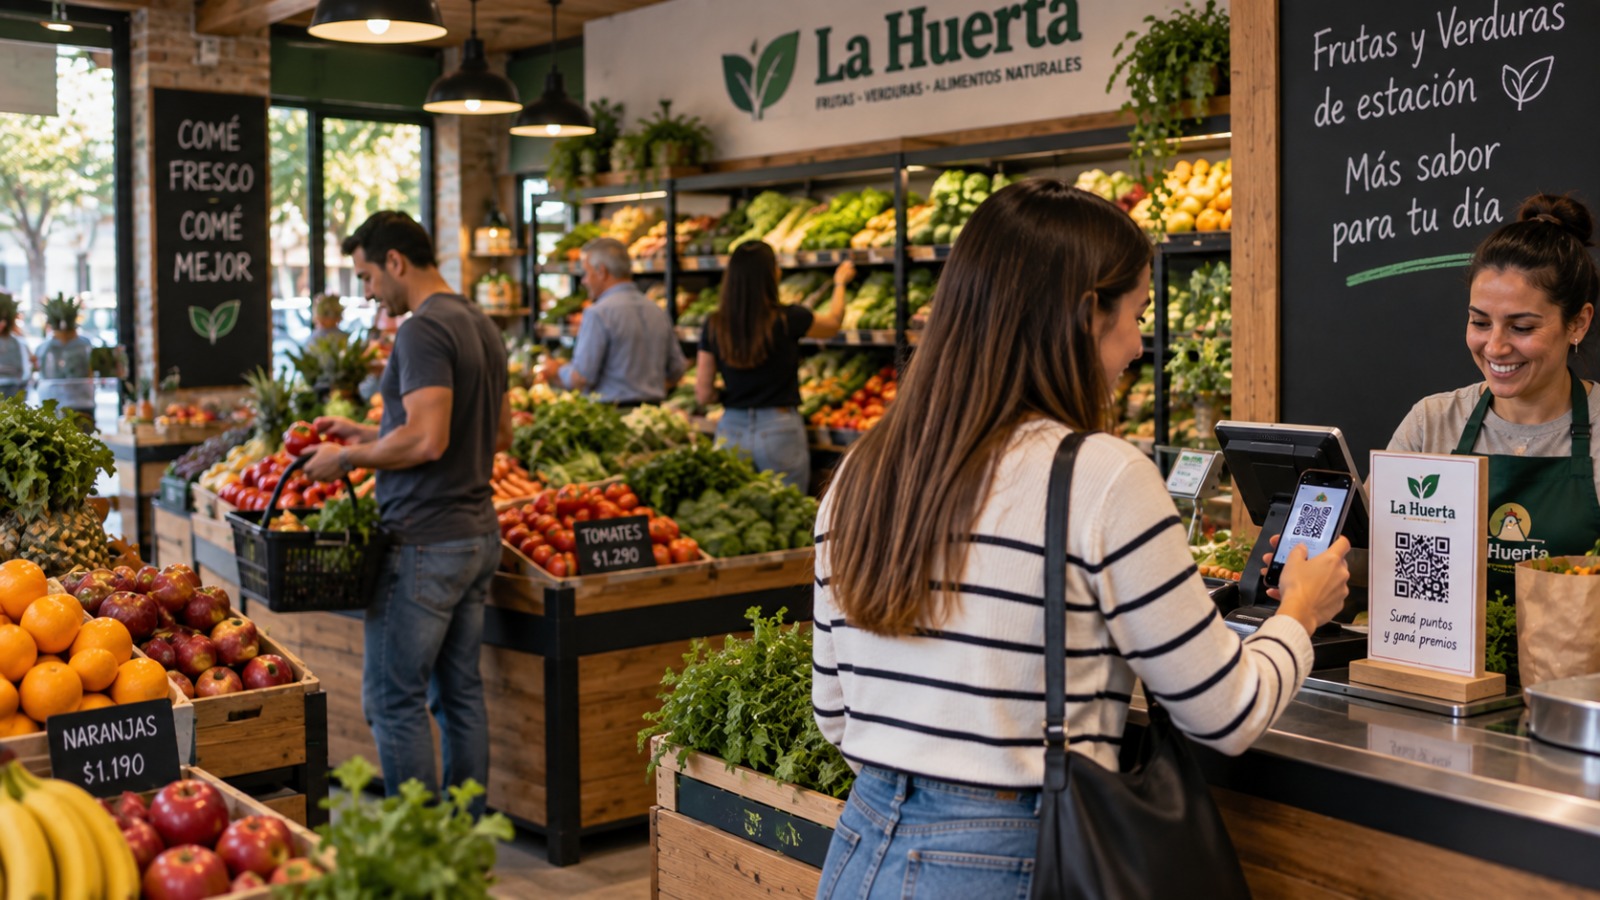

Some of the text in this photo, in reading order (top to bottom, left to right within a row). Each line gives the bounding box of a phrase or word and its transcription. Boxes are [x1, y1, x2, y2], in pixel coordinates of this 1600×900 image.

[815, 0, 1082, 85] La Huerta
[1314, 0, 1566, 71] Frutas y Verduras
[815, 56, 1082, 110] FRUTAS VERDURAS ALIMENTOS NATURALES
[1314, 67, 1478, 128] de estación
[177, 114, 241, 151] COMÉ
[169, 159, 254, 192] FRESCO
[1345, 132, 1501, 195] Más sabor
[180, 203, 244, 241] COMÉ
[1333, 186, 1504, 263] para tu día
[173, 251, 254, 283] MEJOR
[1390, 500, 1456, 520] La Huerta
[580, 523, 643, 545] TOMATES
[592, 546, 639, 568] $1.290
[1487, 543, 1549, 561] Huerta
[1389, 608, 1453, 631] Sumá puntos
[1384, 629, 1457, 650] y ganá premios
[63, 715, 158, 751] NARANJAS
[83, 752, 145, 785] $1.190
